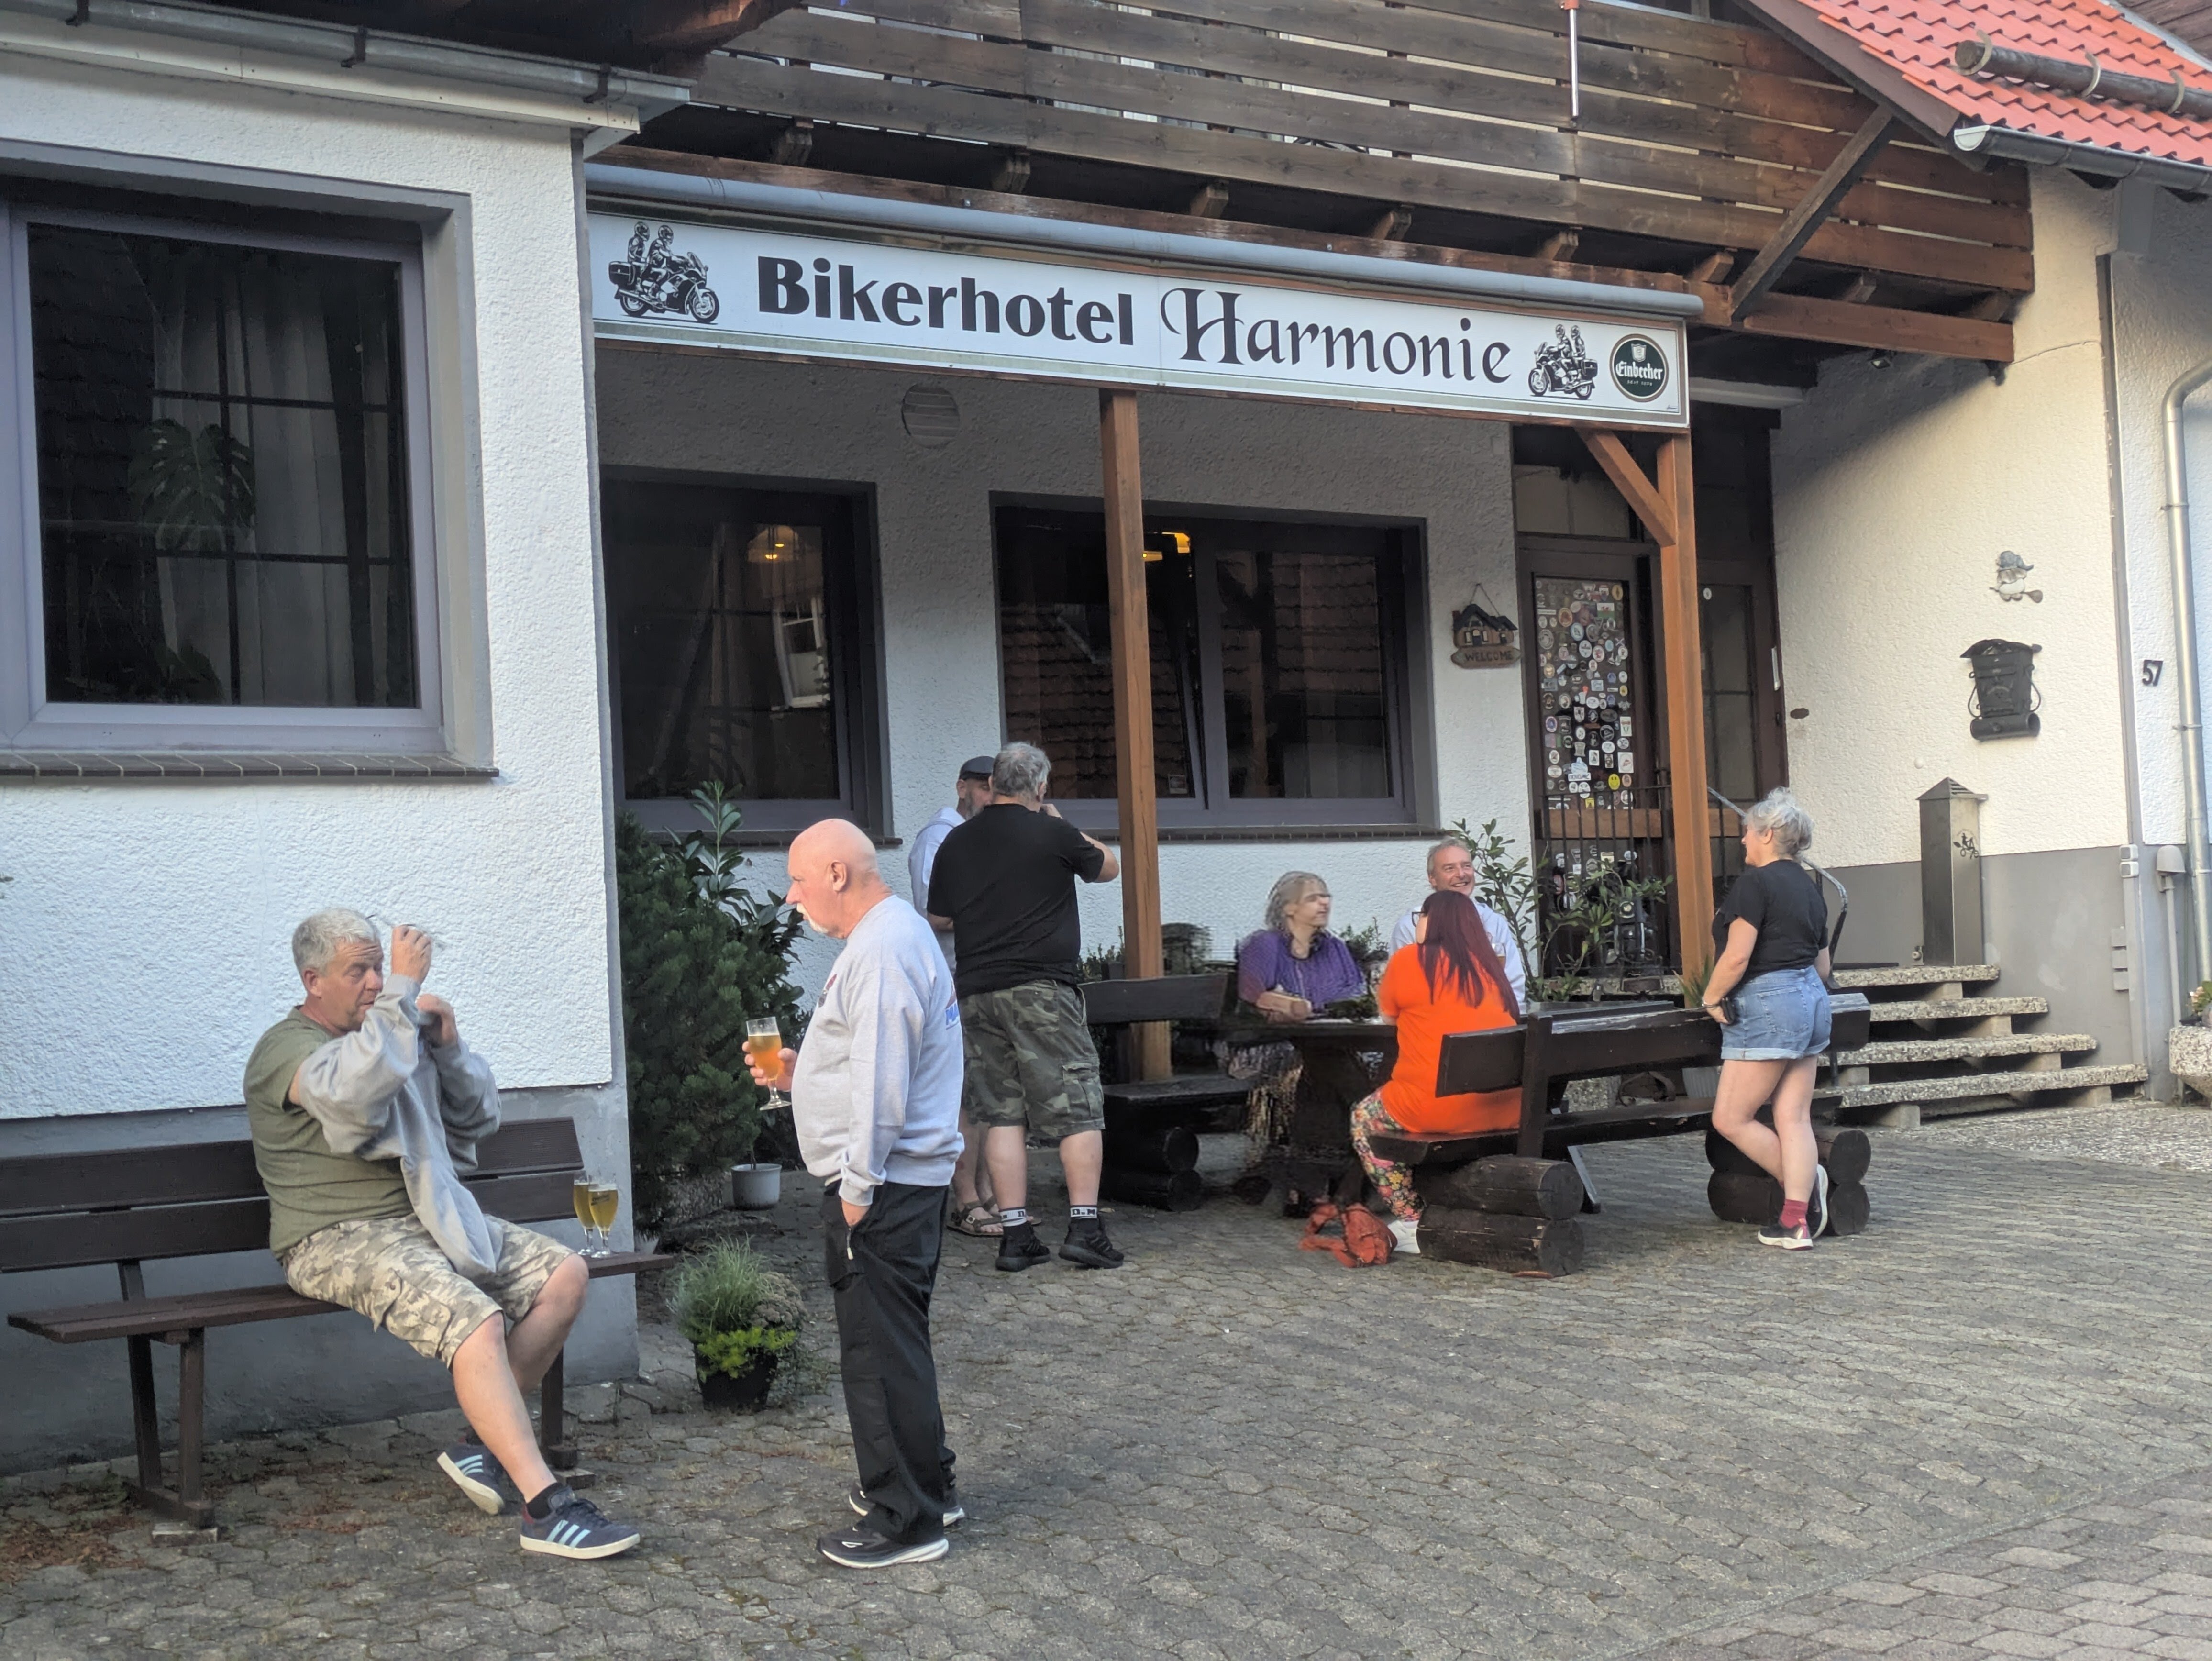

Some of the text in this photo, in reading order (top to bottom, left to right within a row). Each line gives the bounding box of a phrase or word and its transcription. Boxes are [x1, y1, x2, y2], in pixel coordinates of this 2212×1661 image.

[758, 256, 1511, 384] Bikerhotel Harmonie
[1465, 651, 1512, 661] WELCOME
[2142, 660, 2163, 686] 57
